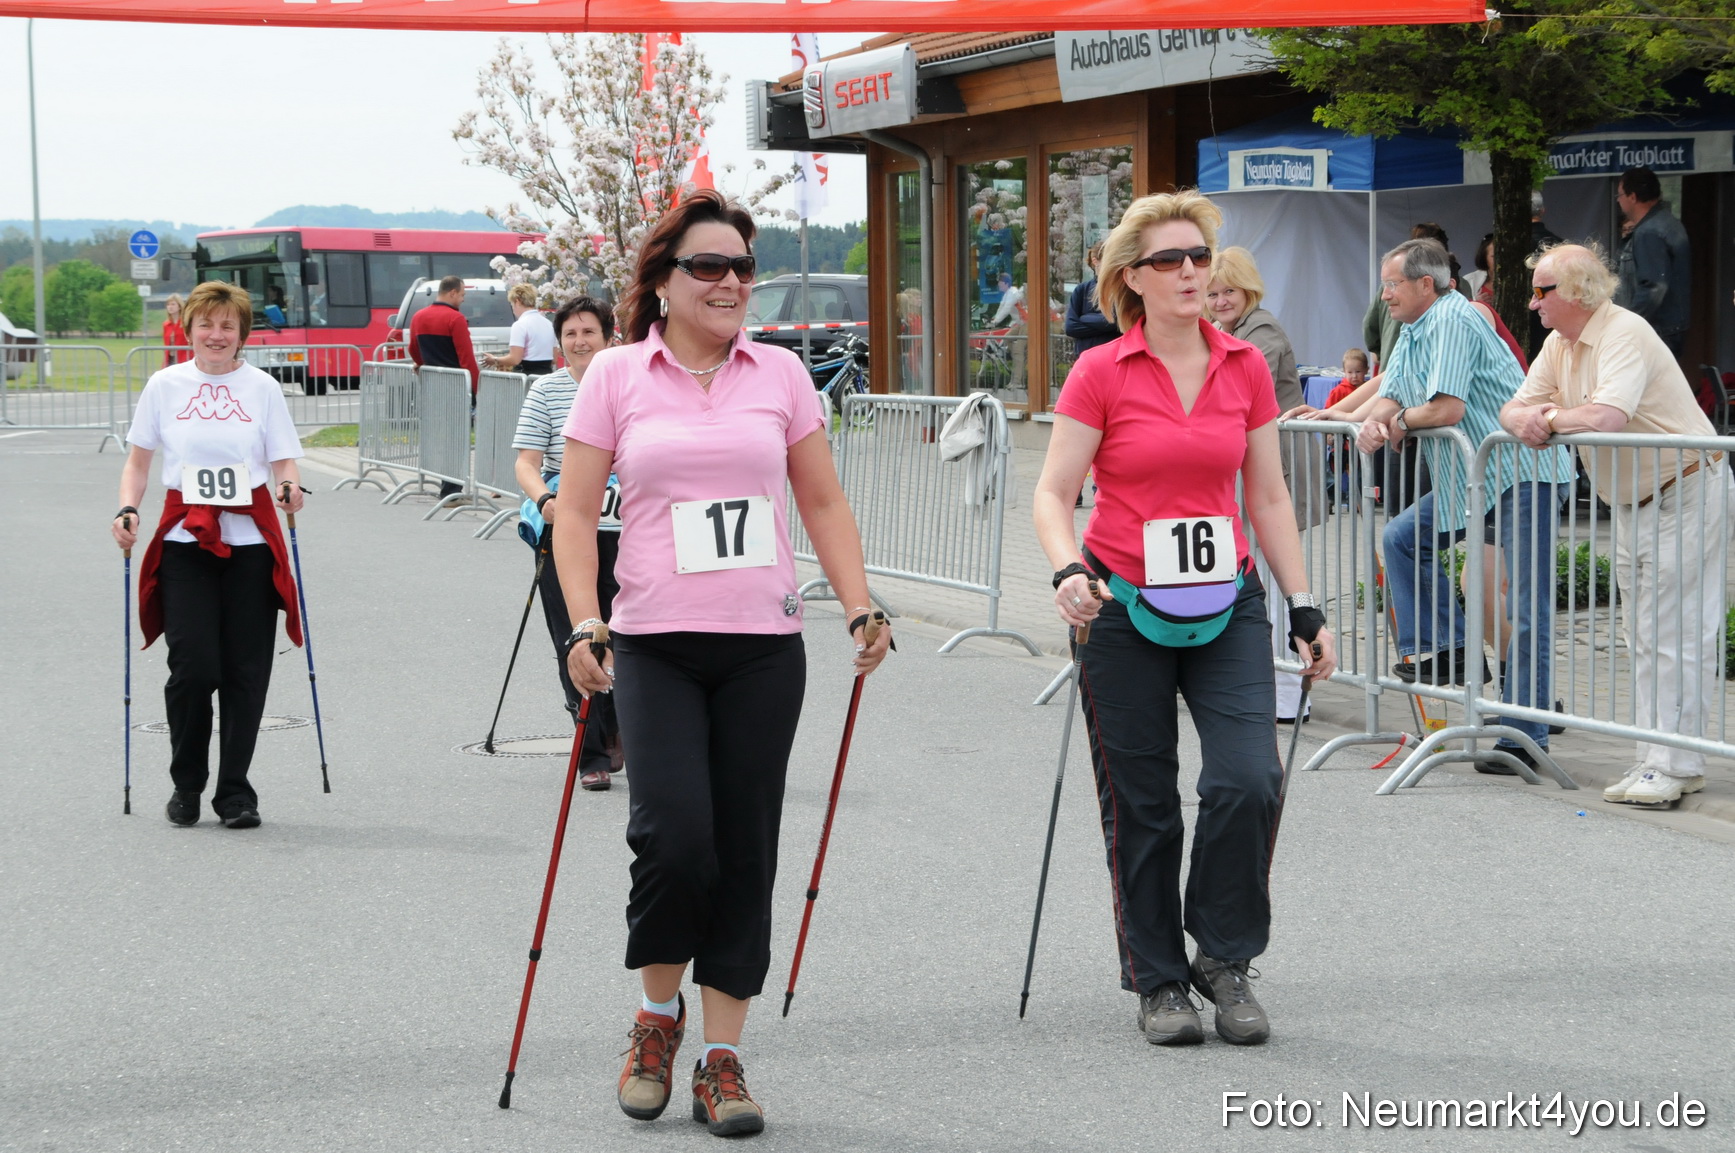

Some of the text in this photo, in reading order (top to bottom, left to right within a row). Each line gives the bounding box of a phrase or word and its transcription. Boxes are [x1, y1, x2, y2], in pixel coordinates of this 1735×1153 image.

[1070, 30, 1152, 71] Autohaus
[834, 72, 893, 109] SEAT
[1282, 160, 1312, 182] Tagblatt
[1615, 145, 1685, 168] Tagblatt
[197, 467, 236, 500] 99
[705, 500, 749, 558] 17
[1171, 520, 1215, 573] 16
